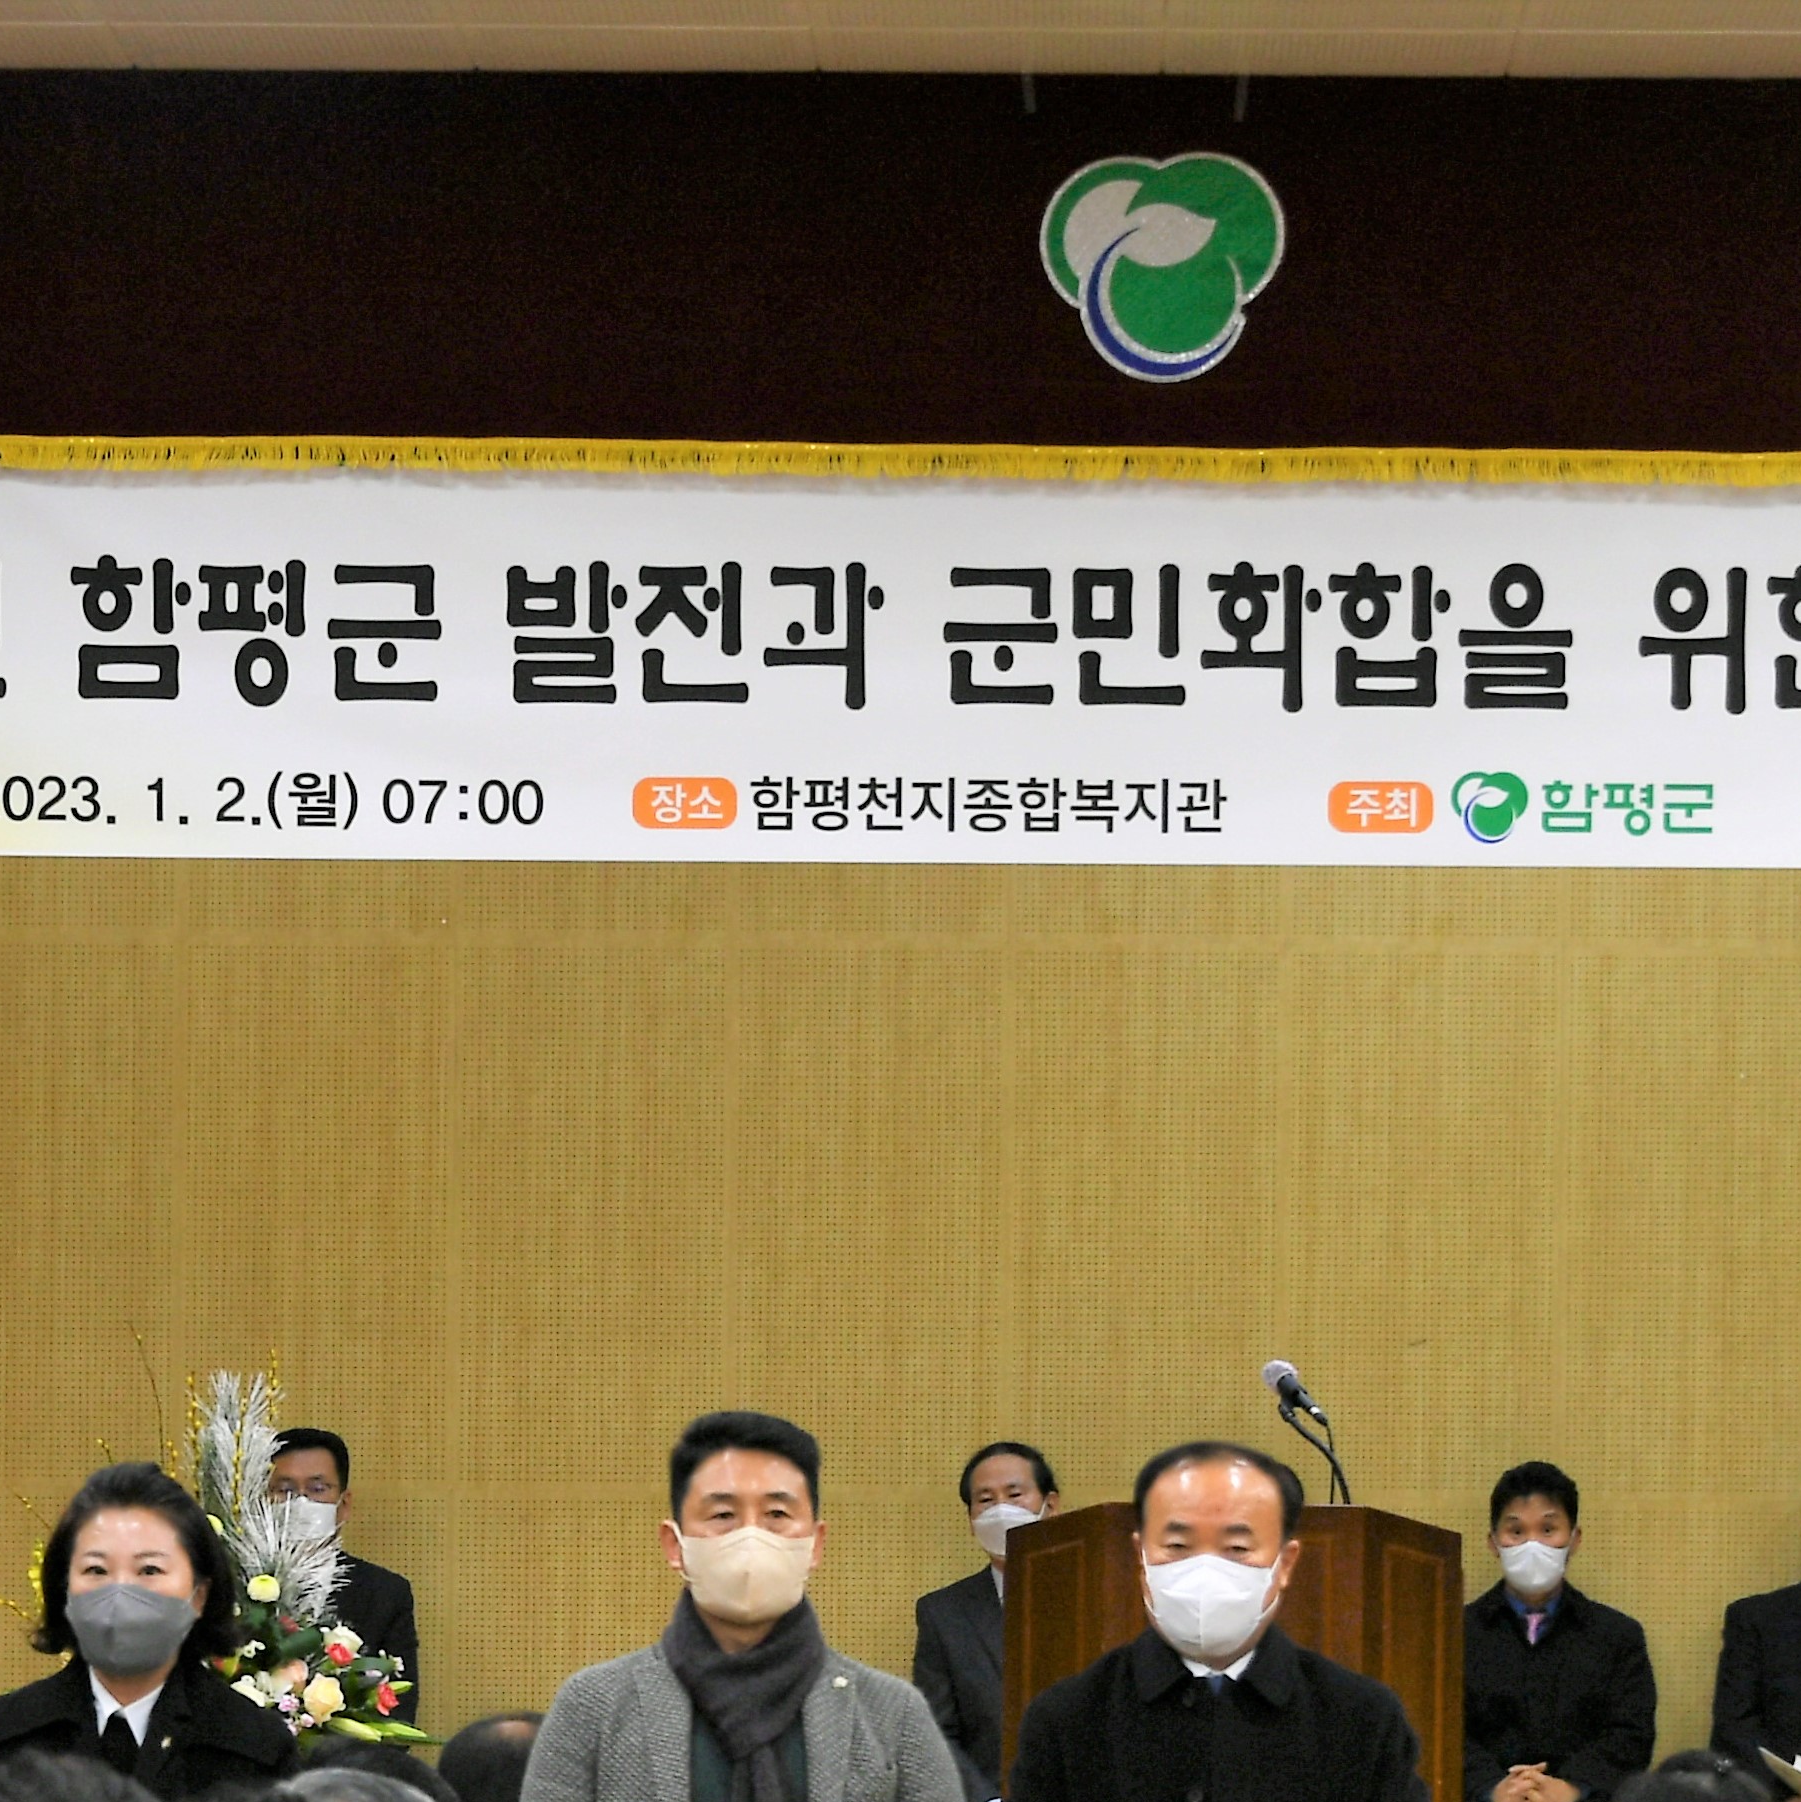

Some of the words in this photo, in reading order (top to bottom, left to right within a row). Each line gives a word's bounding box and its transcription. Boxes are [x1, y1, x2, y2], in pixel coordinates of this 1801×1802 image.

[71, 555, 441, 706] 함평군
[507, 561, 884, 710] 발전과
[944, 562, 1572, 712] 군민화합을
[149, 778, 189, 825] 1.
[216, 772, 358, 830] 2.(월)
[382, 779, 544, 825] 07:00
[651, 784, 724, 822] 장소
[750, 776, 1227, 833] 함평천지종합복지관
[1346, 788, 1420, 827] 주최
[1541, 780, 1713, 836] 함평군
